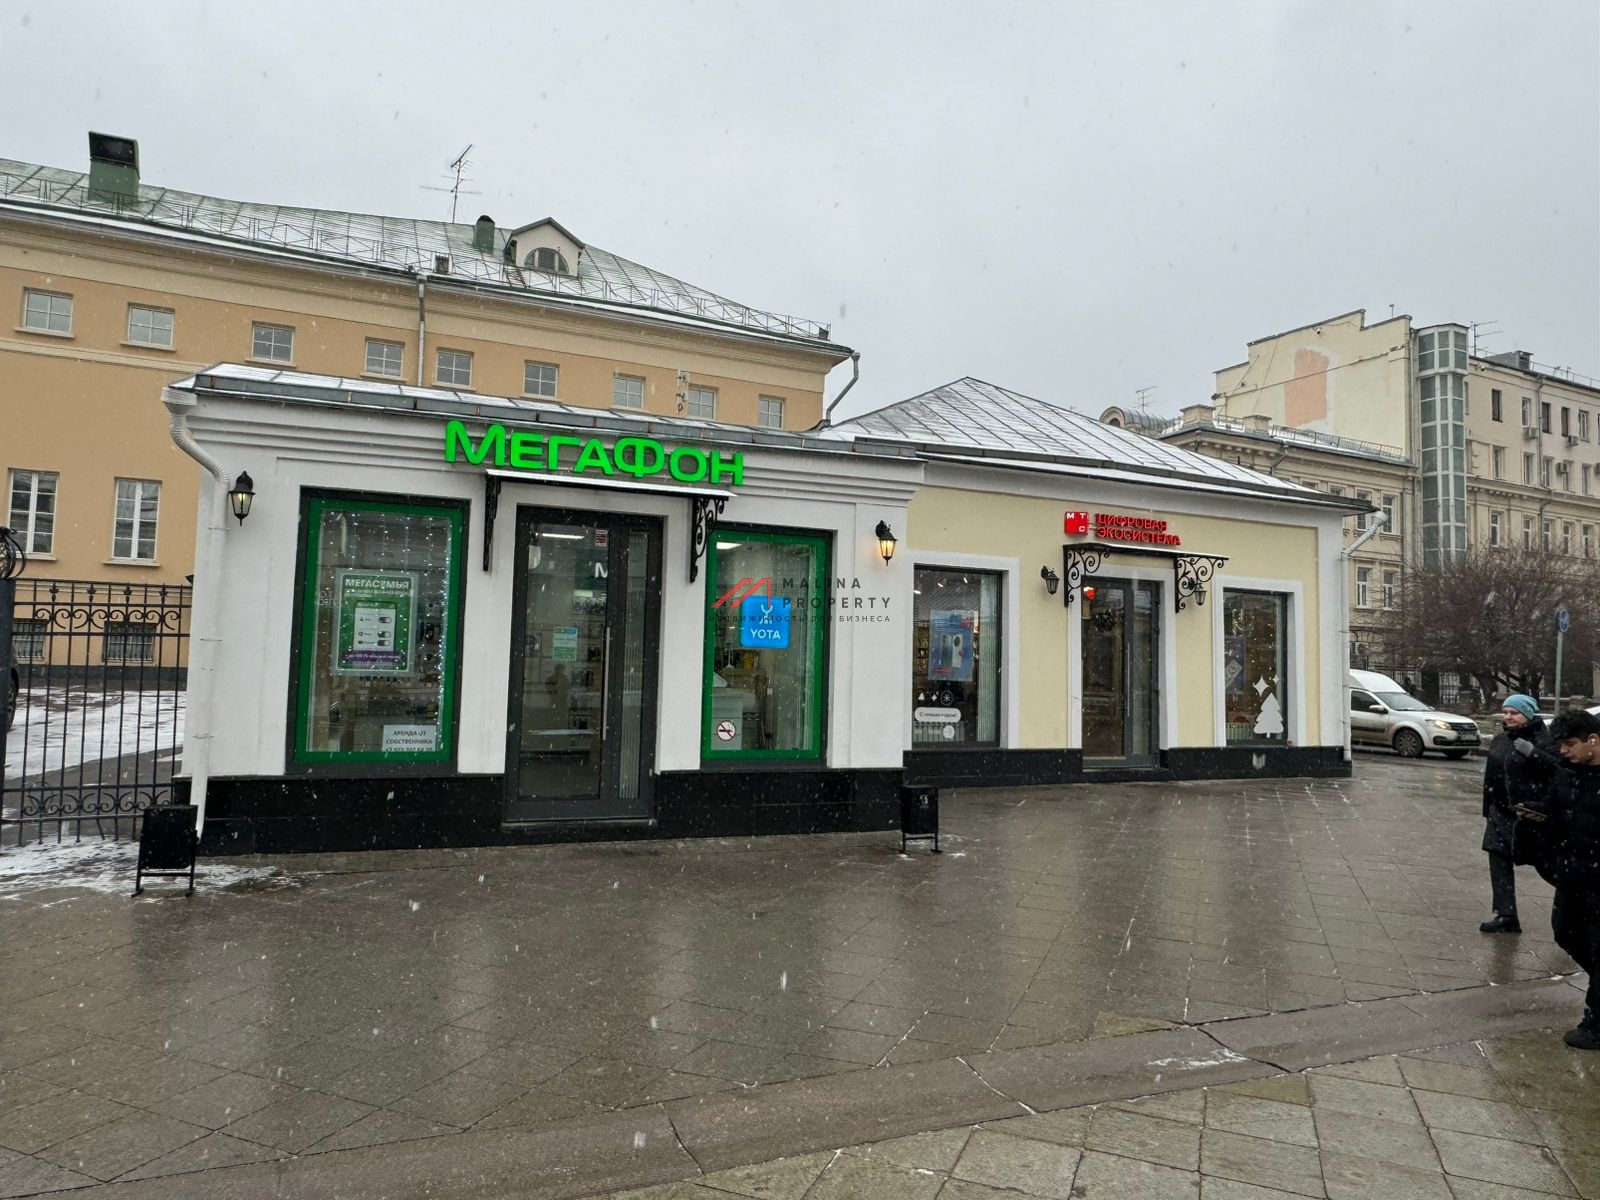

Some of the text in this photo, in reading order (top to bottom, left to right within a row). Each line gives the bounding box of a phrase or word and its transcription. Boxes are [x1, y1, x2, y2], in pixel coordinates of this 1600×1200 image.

[1094, 513, 1168, 531] ЦИФРОВАЯ
[1096, 527, 1181, 545] ЭКОСИСТЕМА
[750, 628, 781, 640] YOTA
